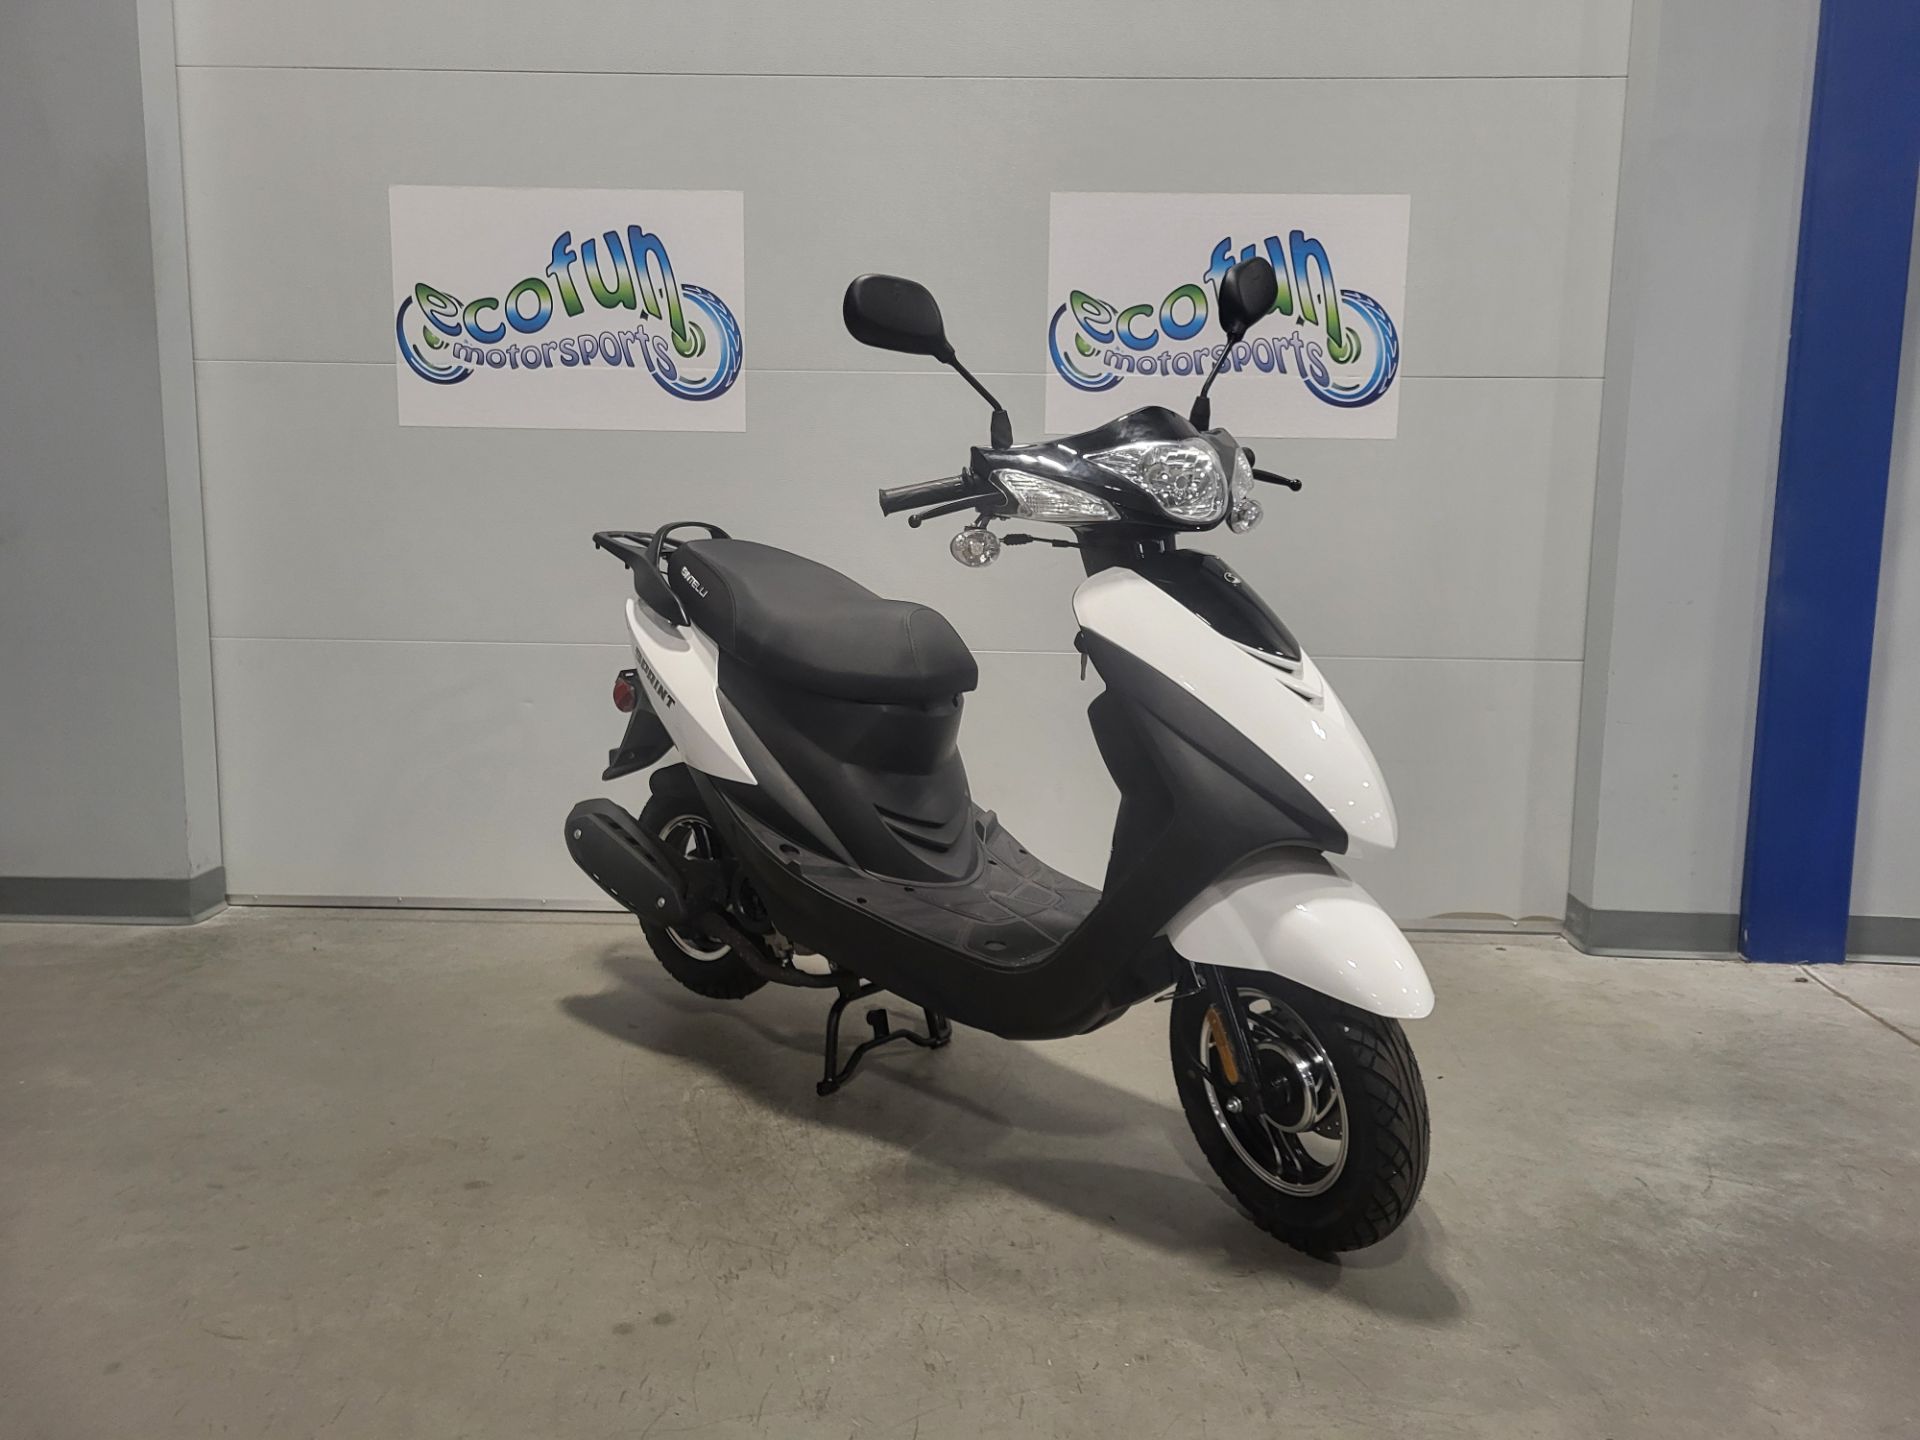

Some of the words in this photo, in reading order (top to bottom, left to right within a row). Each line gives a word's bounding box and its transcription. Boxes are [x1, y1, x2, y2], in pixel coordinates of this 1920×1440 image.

[415, 225, 687, 344] ecofun
[453, 324, 678, 382] motorsports
[1103, 330, 1331, 389] motorsports
